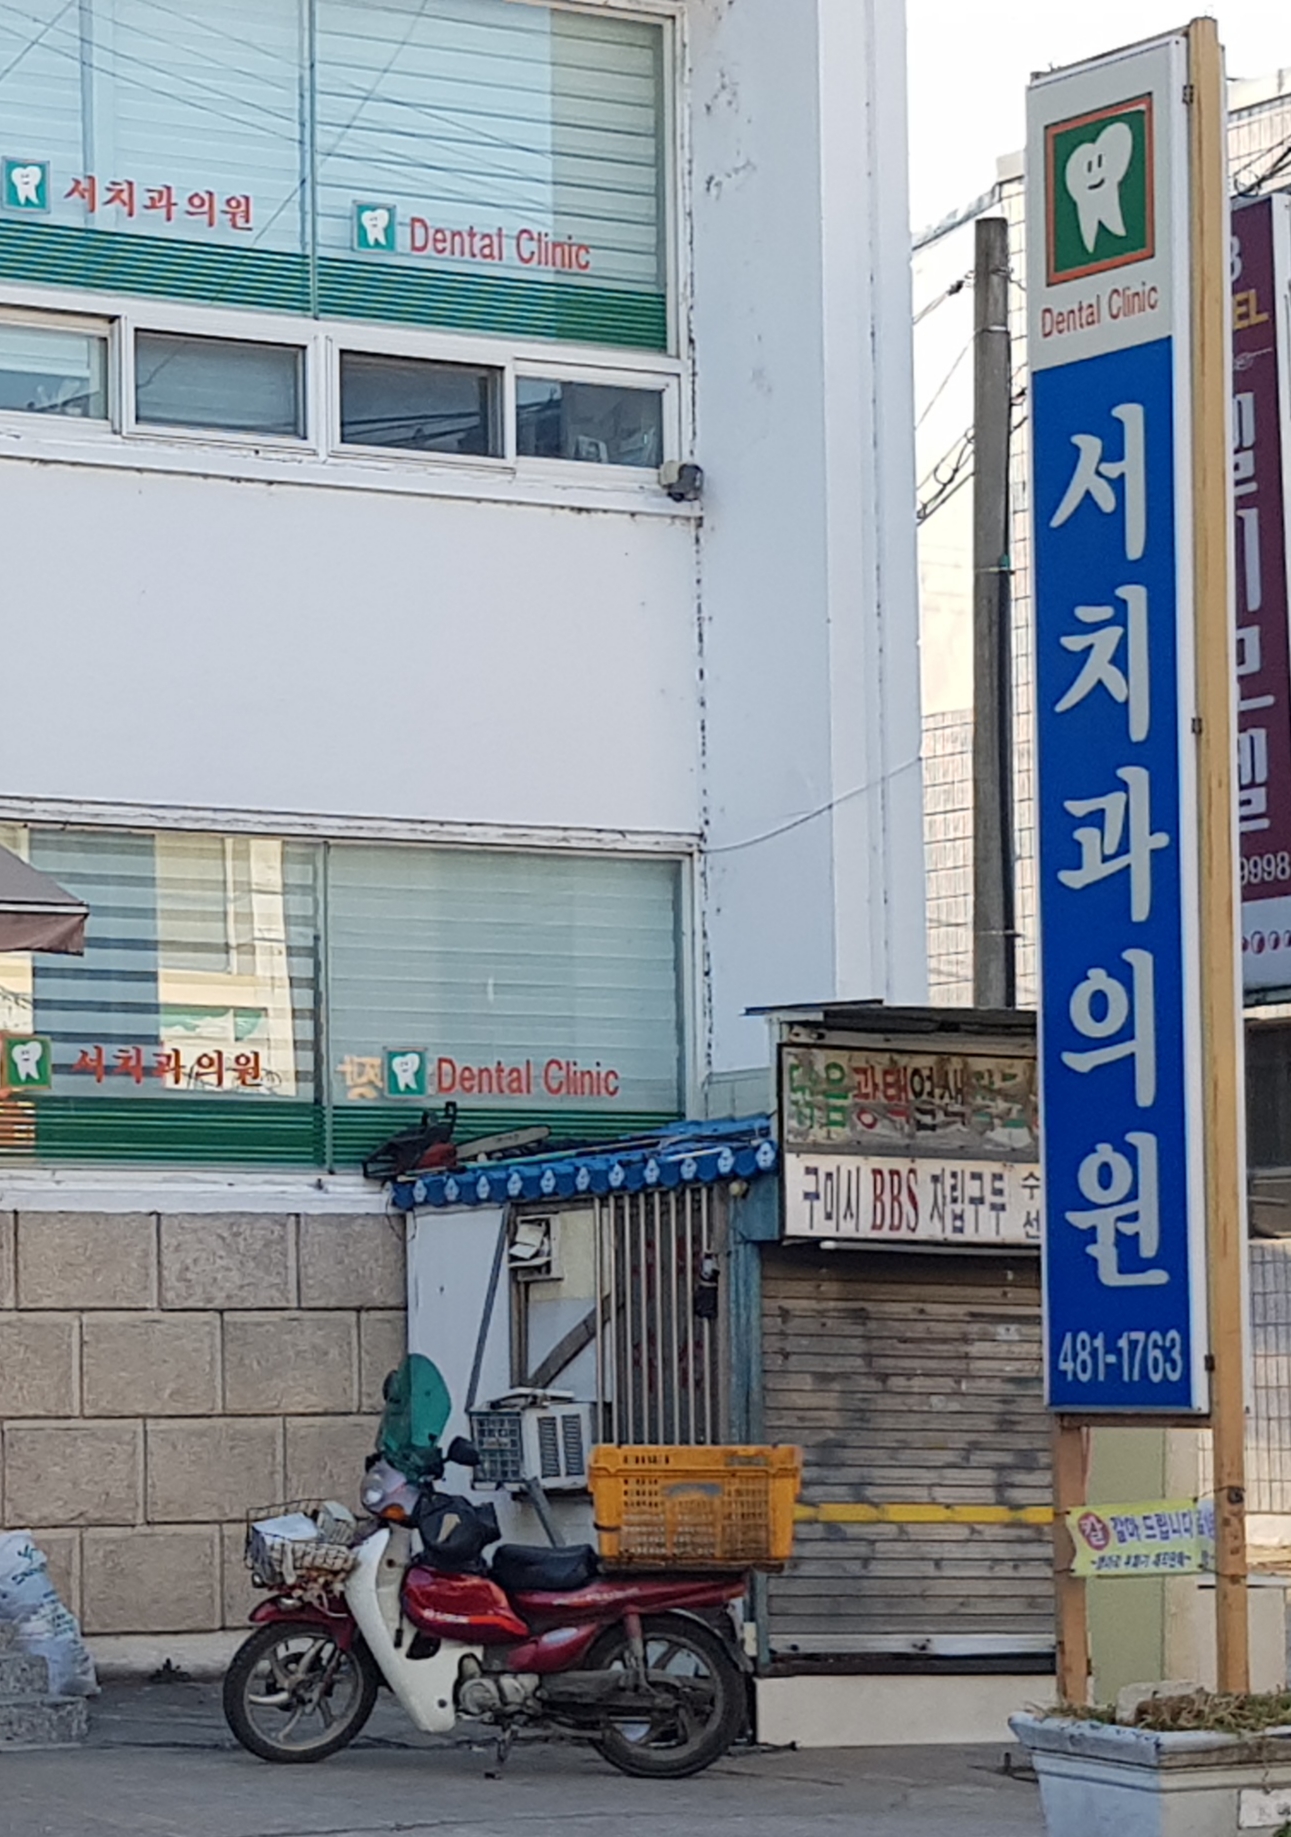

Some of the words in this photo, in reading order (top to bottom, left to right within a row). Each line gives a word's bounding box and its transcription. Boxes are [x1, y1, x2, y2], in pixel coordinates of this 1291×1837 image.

[64, 175, 254, 232] 서치과의원
[410, 217, 504, 262] Dental
[516, 228, 591, 271] Clinic
[1041, 294, 1102, 339] Dental
[1108, 281, 1159, 320] Clinic
[1233, 288, 1270, 331] EL
[1050, 403, 1170, 1286] 서치과의원
[72, 1044, 263, 1088] 서치과의원
[437, 1057, 532, 1095] Dental
[543, 1059, 620, 1097] Clinic
[803, 1165, 861, 1233] 구미시
[871, 1168, 920, 1234] BBS
[930, 1167, 1007, 1237] 자립구두
[1058, 1329, 1184, 1383] 481-1763
